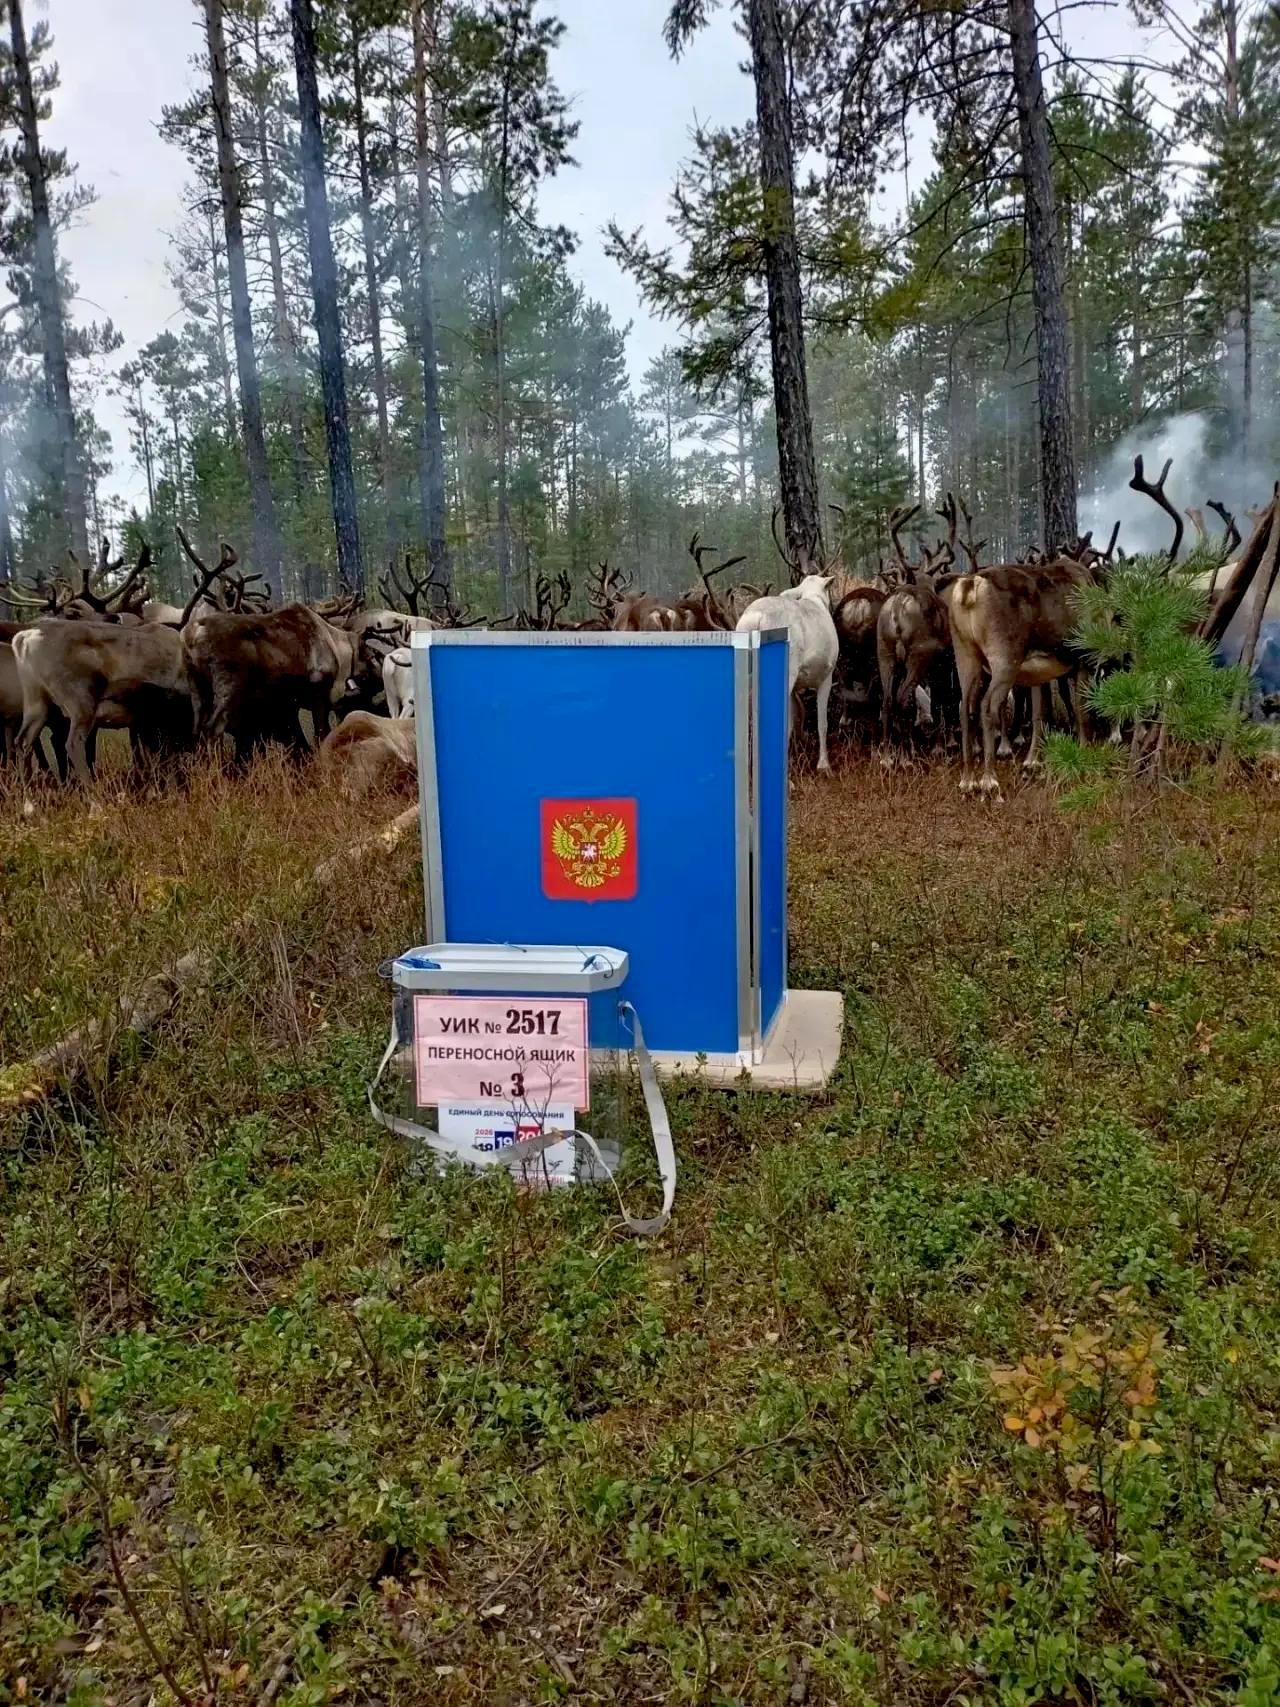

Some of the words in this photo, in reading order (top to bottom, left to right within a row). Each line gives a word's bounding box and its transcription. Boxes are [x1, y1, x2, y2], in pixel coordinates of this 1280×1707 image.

[440, 1017, 480, 1034] УИК
[485, 1021, 502, 1034] №
[506, 1009, 562, 1035] 2517
[428, 1046, 526, 1061] ПЕРЕНОСНОЙ
[530, 1049, 575, 1063] ЯЩИК
[480, 1081, 502, 1097] №
[511, 1072, 525, 1097] 3
